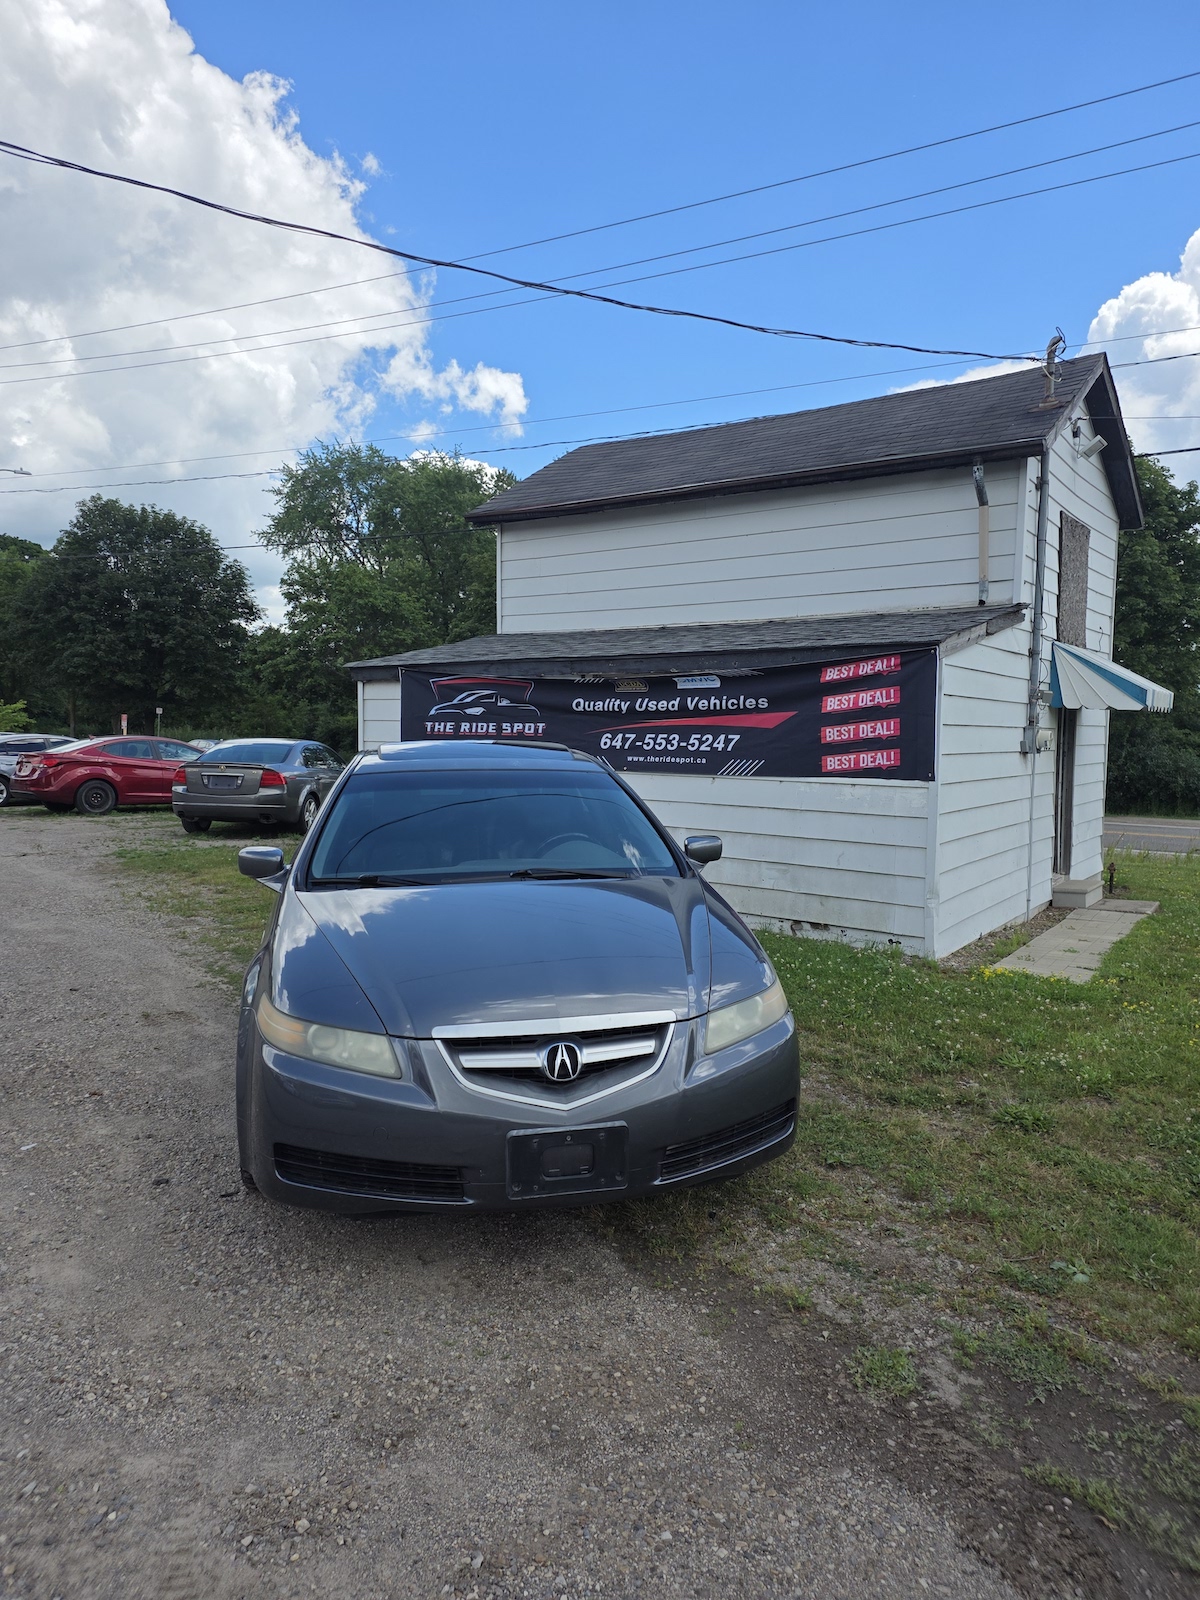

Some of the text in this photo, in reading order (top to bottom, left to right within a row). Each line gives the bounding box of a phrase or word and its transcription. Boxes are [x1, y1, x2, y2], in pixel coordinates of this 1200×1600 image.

[825, 657, 895, 680] BEST DEAL!
[572, 695, 769, 714] Quality Used Vehicles
[826, 689, 894, 711] BEST DEAL!
[424, 722, 546, 737] THE RIDE SPOT
[825, 721, 894, 741] BEST DEAL!
[600, 733, 741, 752] 647-553-5247
[627, 756, 707, 764] www.theridespot.ca
[826, 751, 895, 770] BEST DEAL!
